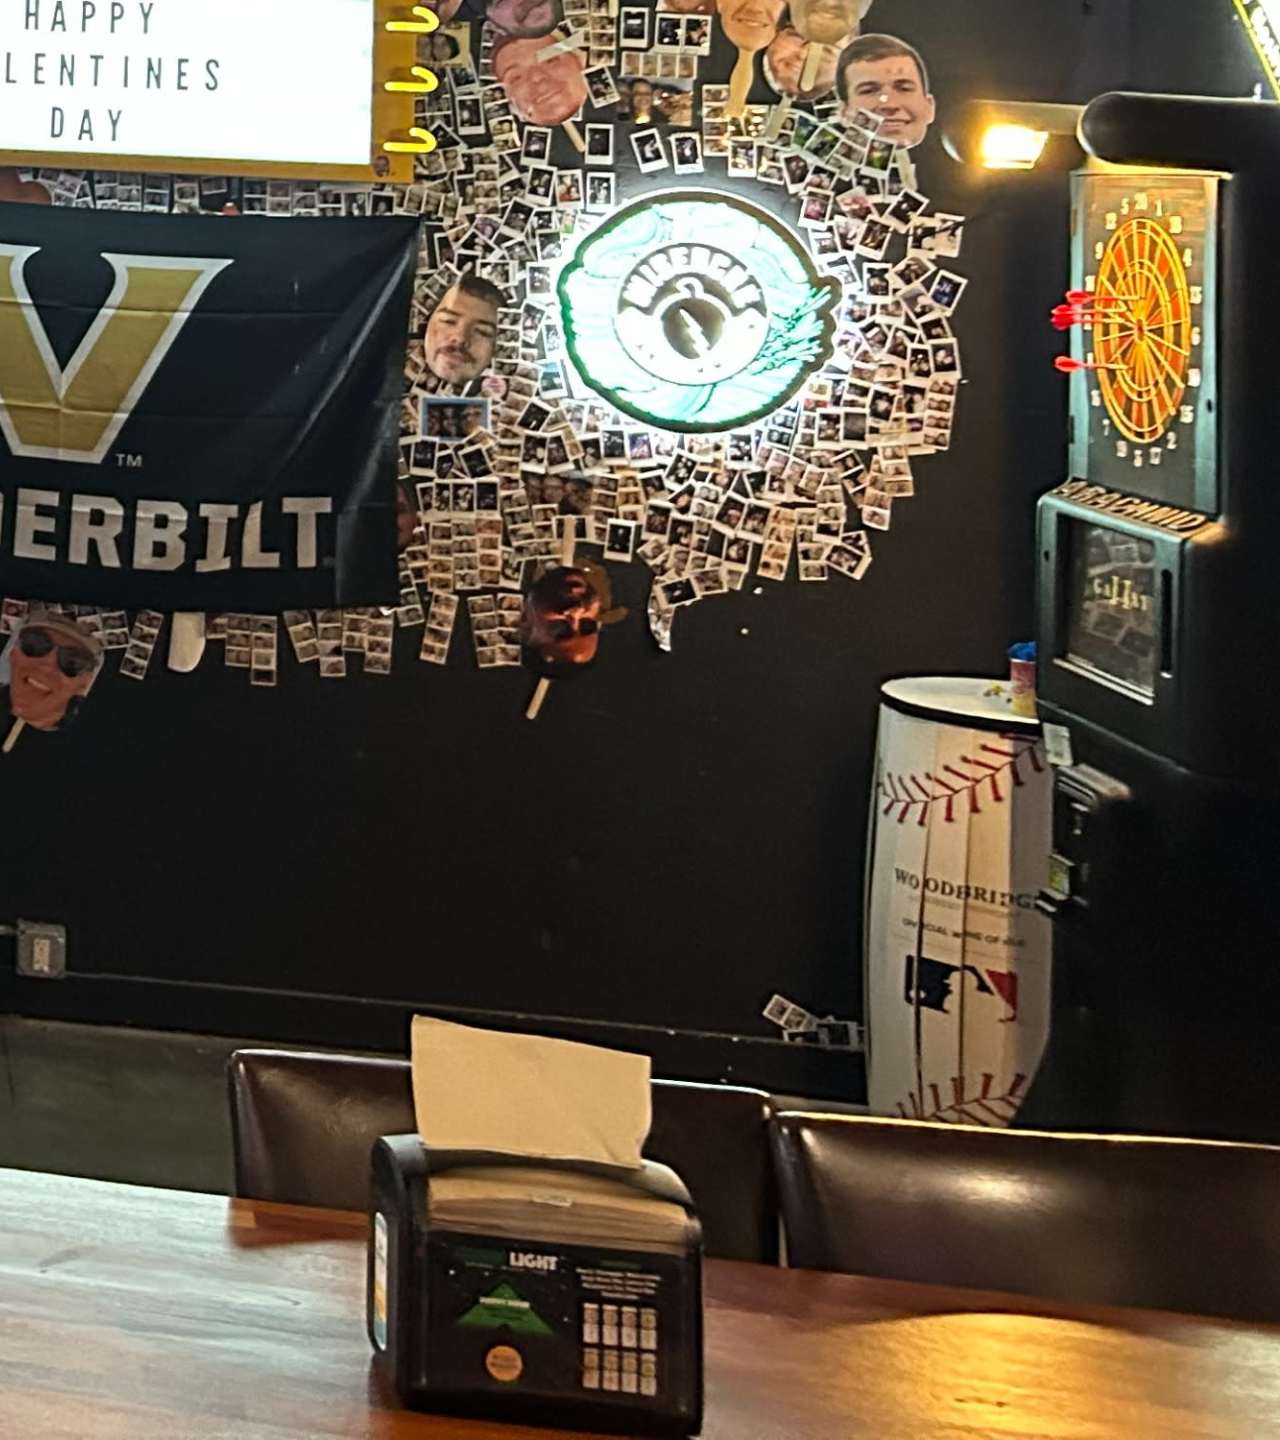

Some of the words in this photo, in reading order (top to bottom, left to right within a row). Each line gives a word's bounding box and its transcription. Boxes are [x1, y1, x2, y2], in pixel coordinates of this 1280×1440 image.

[50, 106, 124, 142] DAY
[116, 452, 143, 467] TM
[894, 867, 1038, 911] WOODBRIDG
[510, 1251, 558, 1271] LIGHT
